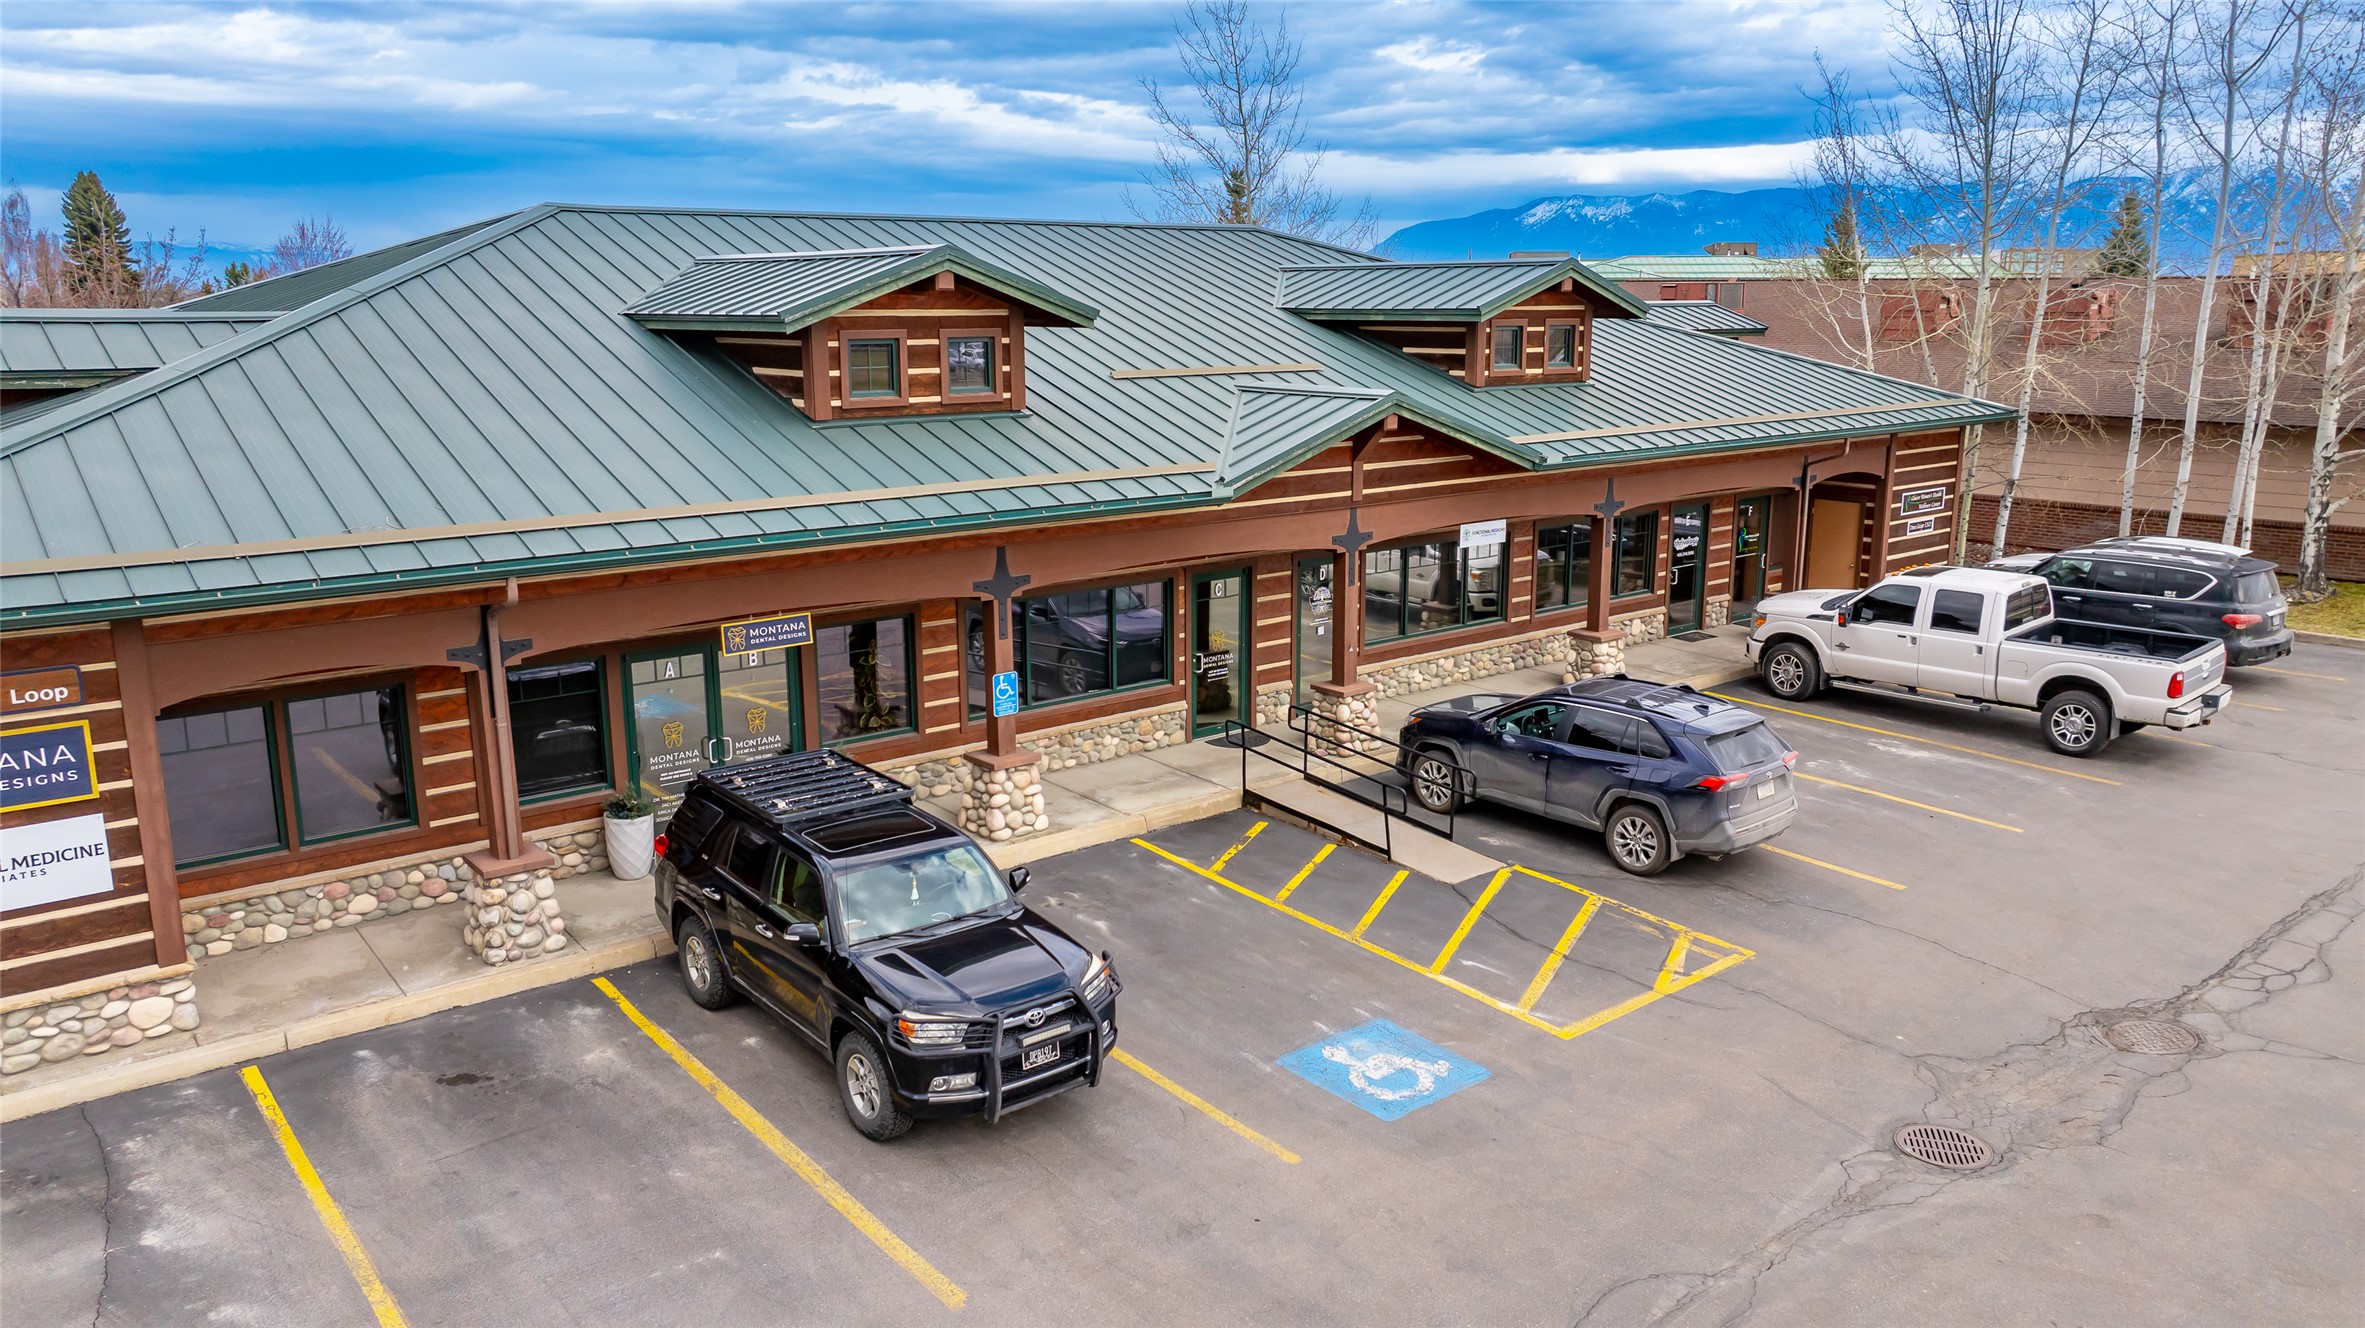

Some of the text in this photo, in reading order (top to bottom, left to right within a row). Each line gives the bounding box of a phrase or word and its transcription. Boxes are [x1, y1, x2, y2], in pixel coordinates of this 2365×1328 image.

[1319, 568, 1326, 581] D
[1215, 582, 1223, 597] C
[749, 621, 806, 638] MONTANA
[750, 631, 807, 645] DENTAL DESIGNS
[749, 651, 758, 667] B
[1203, 652, 1234, 664] MONTANA
[664, 661, 676, 679] A
[10, 686, 69, 705] Loop
[735, 734, 781, 750] MONTANA
[736, 742, 782, 755] DENTAL DESIGNS
[649, 749, 700, 765] MONTANA
[650, 757, 700, 771] DENTAL DESIGNS
[11, 843, 105, 871] MEDICINE
[2, 867, 47, 883] IATES
